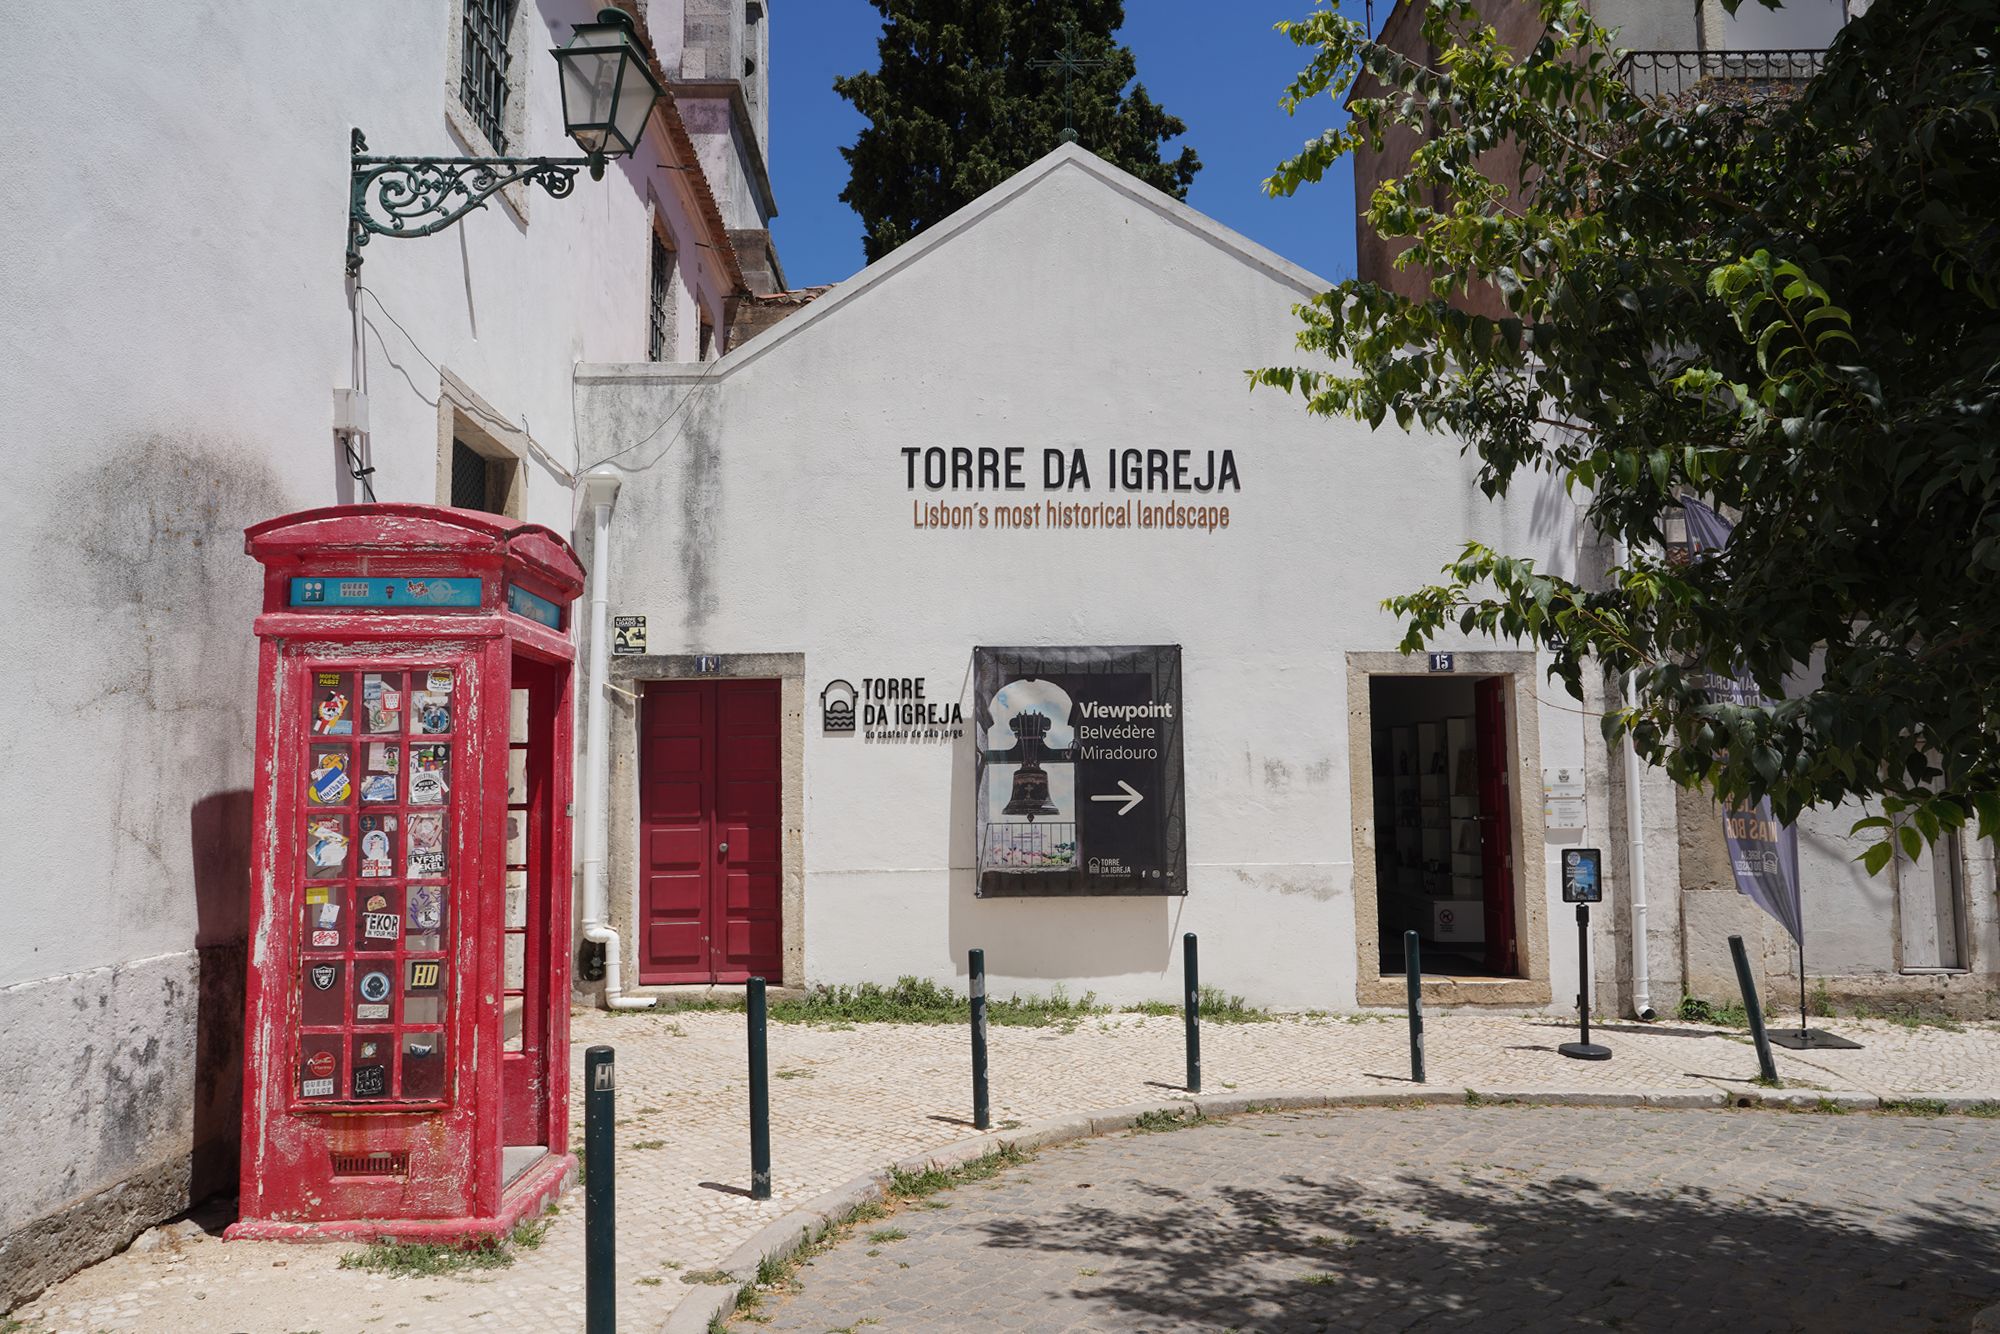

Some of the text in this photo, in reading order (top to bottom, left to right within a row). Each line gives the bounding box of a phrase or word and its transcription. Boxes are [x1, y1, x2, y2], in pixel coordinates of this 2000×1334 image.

[901, 446, 1241, 491] TORRE DA IGREJA
[994, 502, 1041, 528] most
[1046, 499, 1131, 528] historical
[1137, 499, 1230, 535] landscape
[1435, 654, 1449, 670] 15
[863, 677, 926, 700] TORRE
[864, 703, 963, 725] DA IGREJA
[1080, 701, 1173, 722] Viewpoint
[865, 730, 875, 739] do
[911, 729, 924, 738] de
[924, 728, 939, 738] são
[941, 729, 963, 740] jorge
[1080, 724, 1155, 739] Belvédère
[1080, 746, 1158, 760] Miradouro
[1101, 858, 1120, 866] TORRE
[1101, 866, 1131, 874] DA IGREJA
[412, 964, 438, 986] HD
